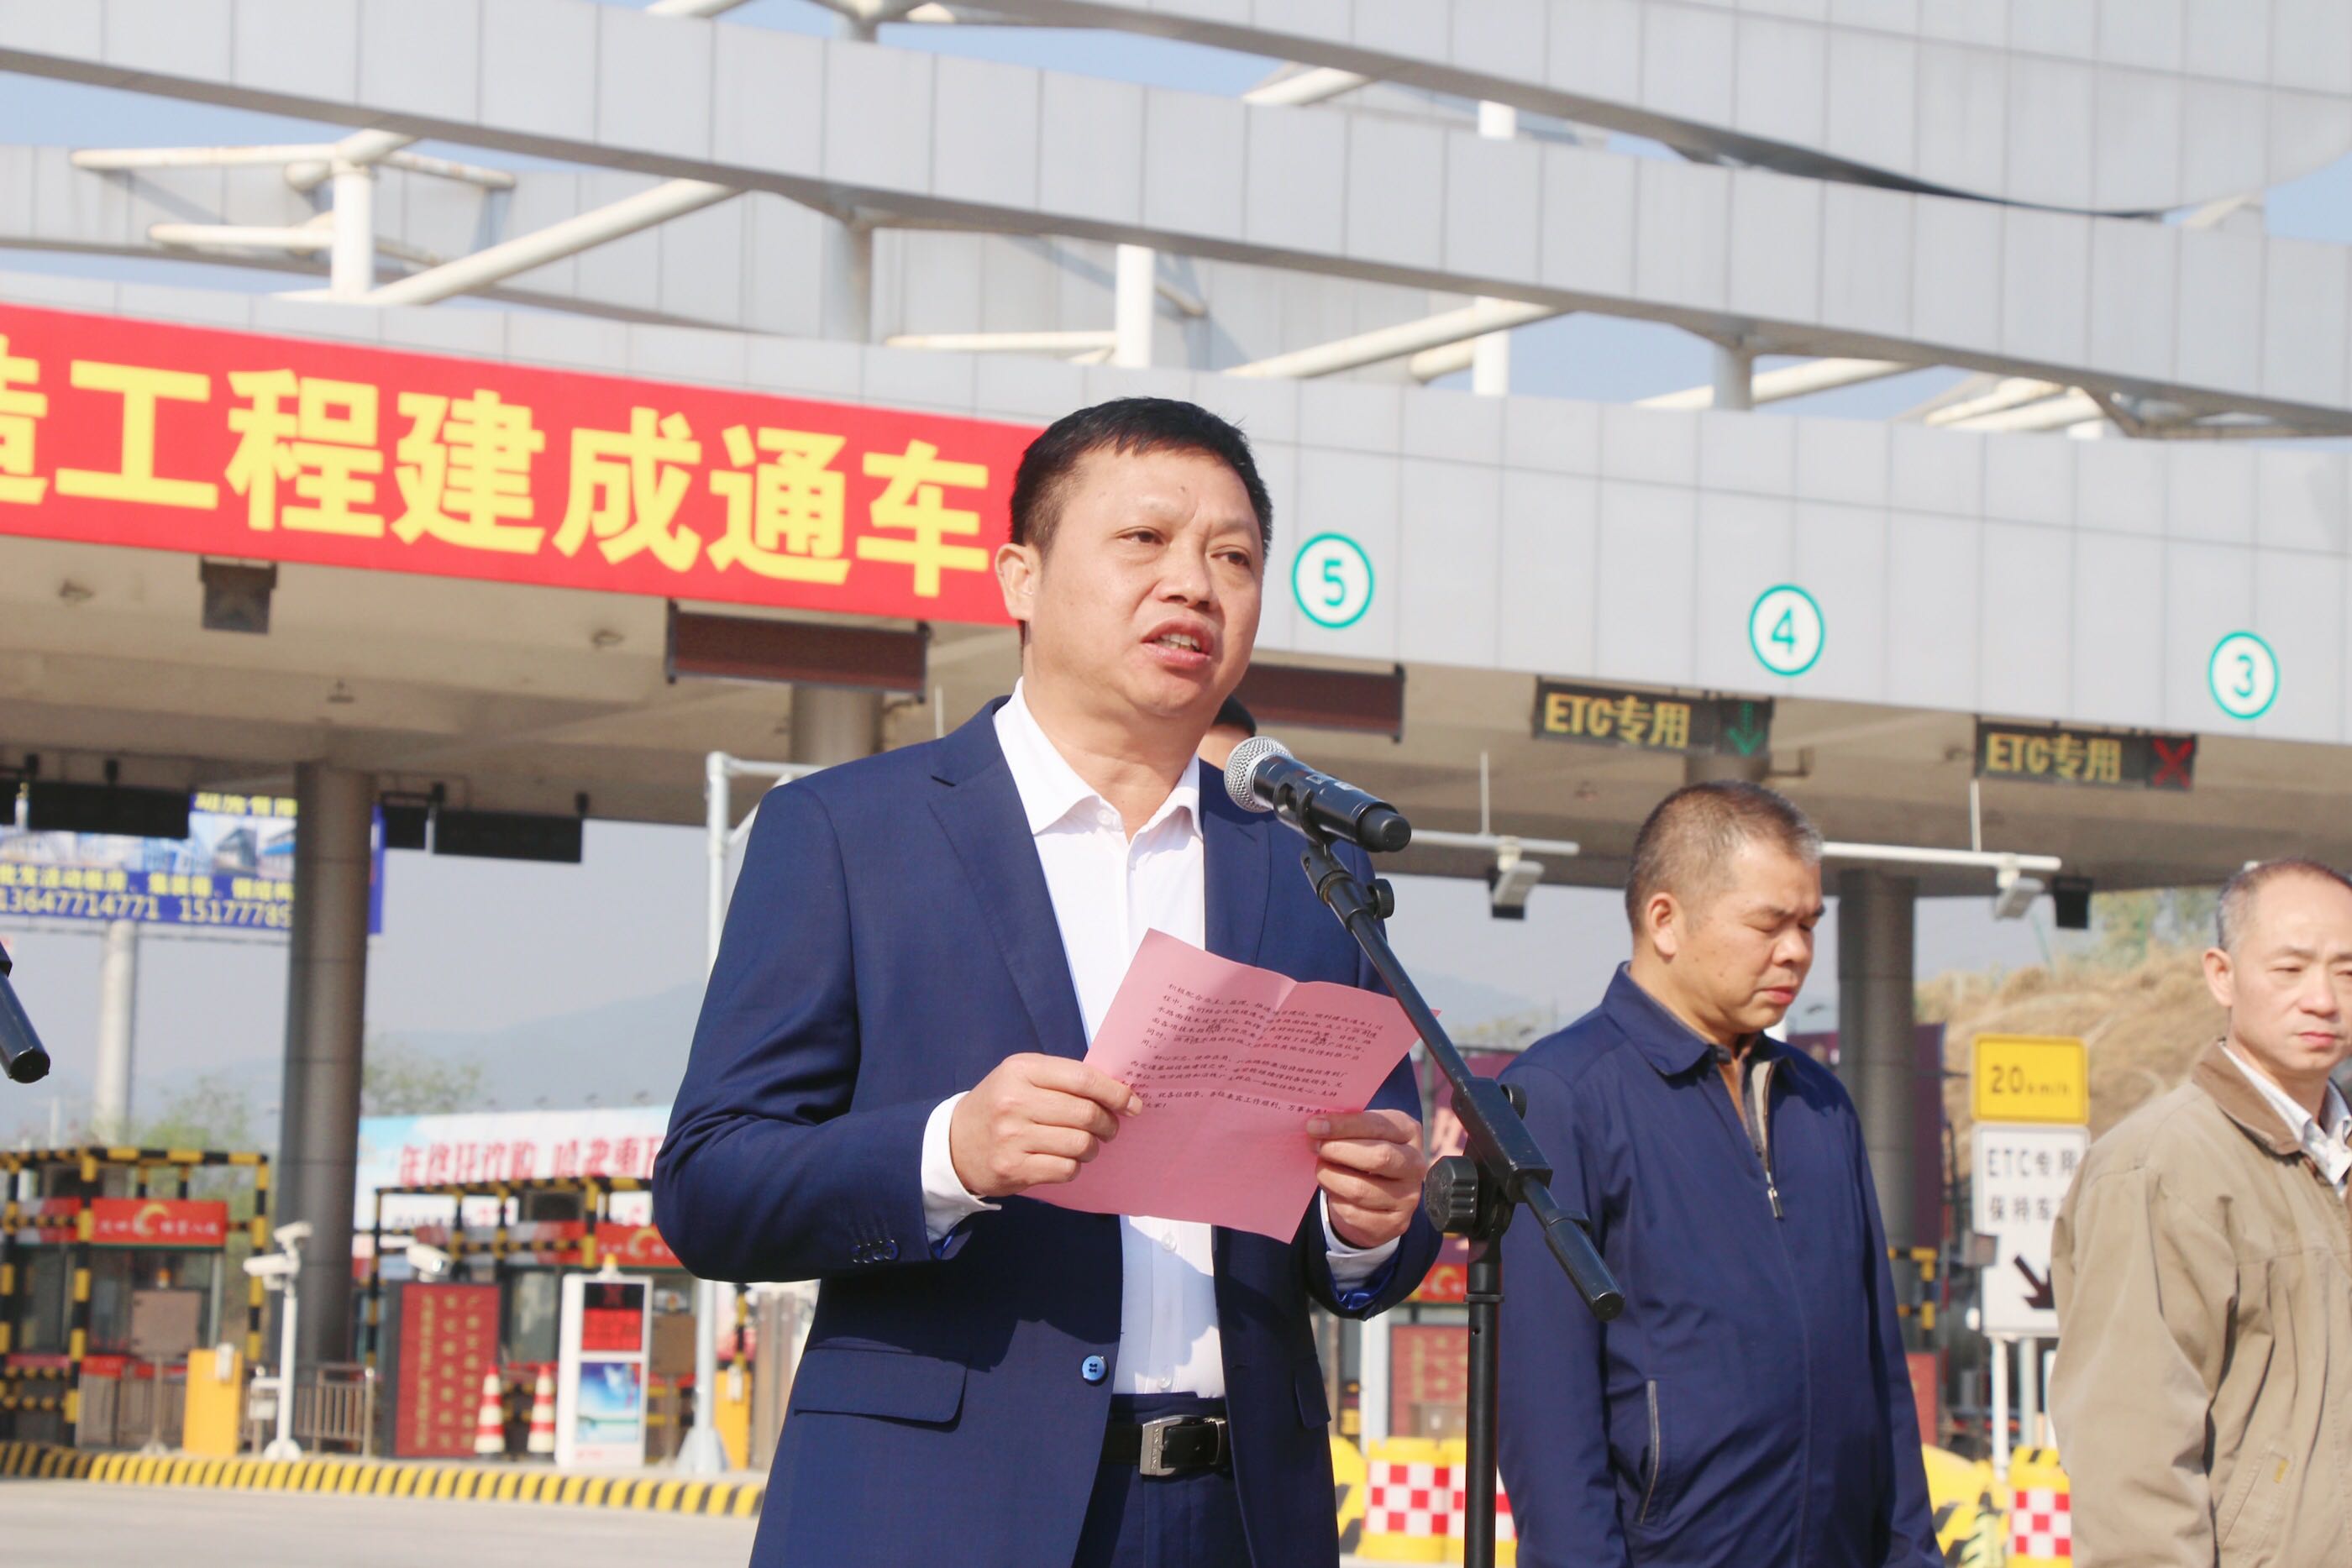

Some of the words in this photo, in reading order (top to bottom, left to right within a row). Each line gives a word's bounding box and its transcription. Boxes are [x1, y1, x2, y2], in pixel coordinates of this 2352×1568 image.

[1322, 559, 1347, 607] 5
[1771, 606, 1798, 653] 4
[2232, 653, 2255, 698] 3
[1543, 692, 1692, 747] ETC专用
[1985, 732, 2122, 783] ETC专用
[1991, 1064, 2024, 1094] 20
[1988, 1195, 2065, 1223] 保持车
